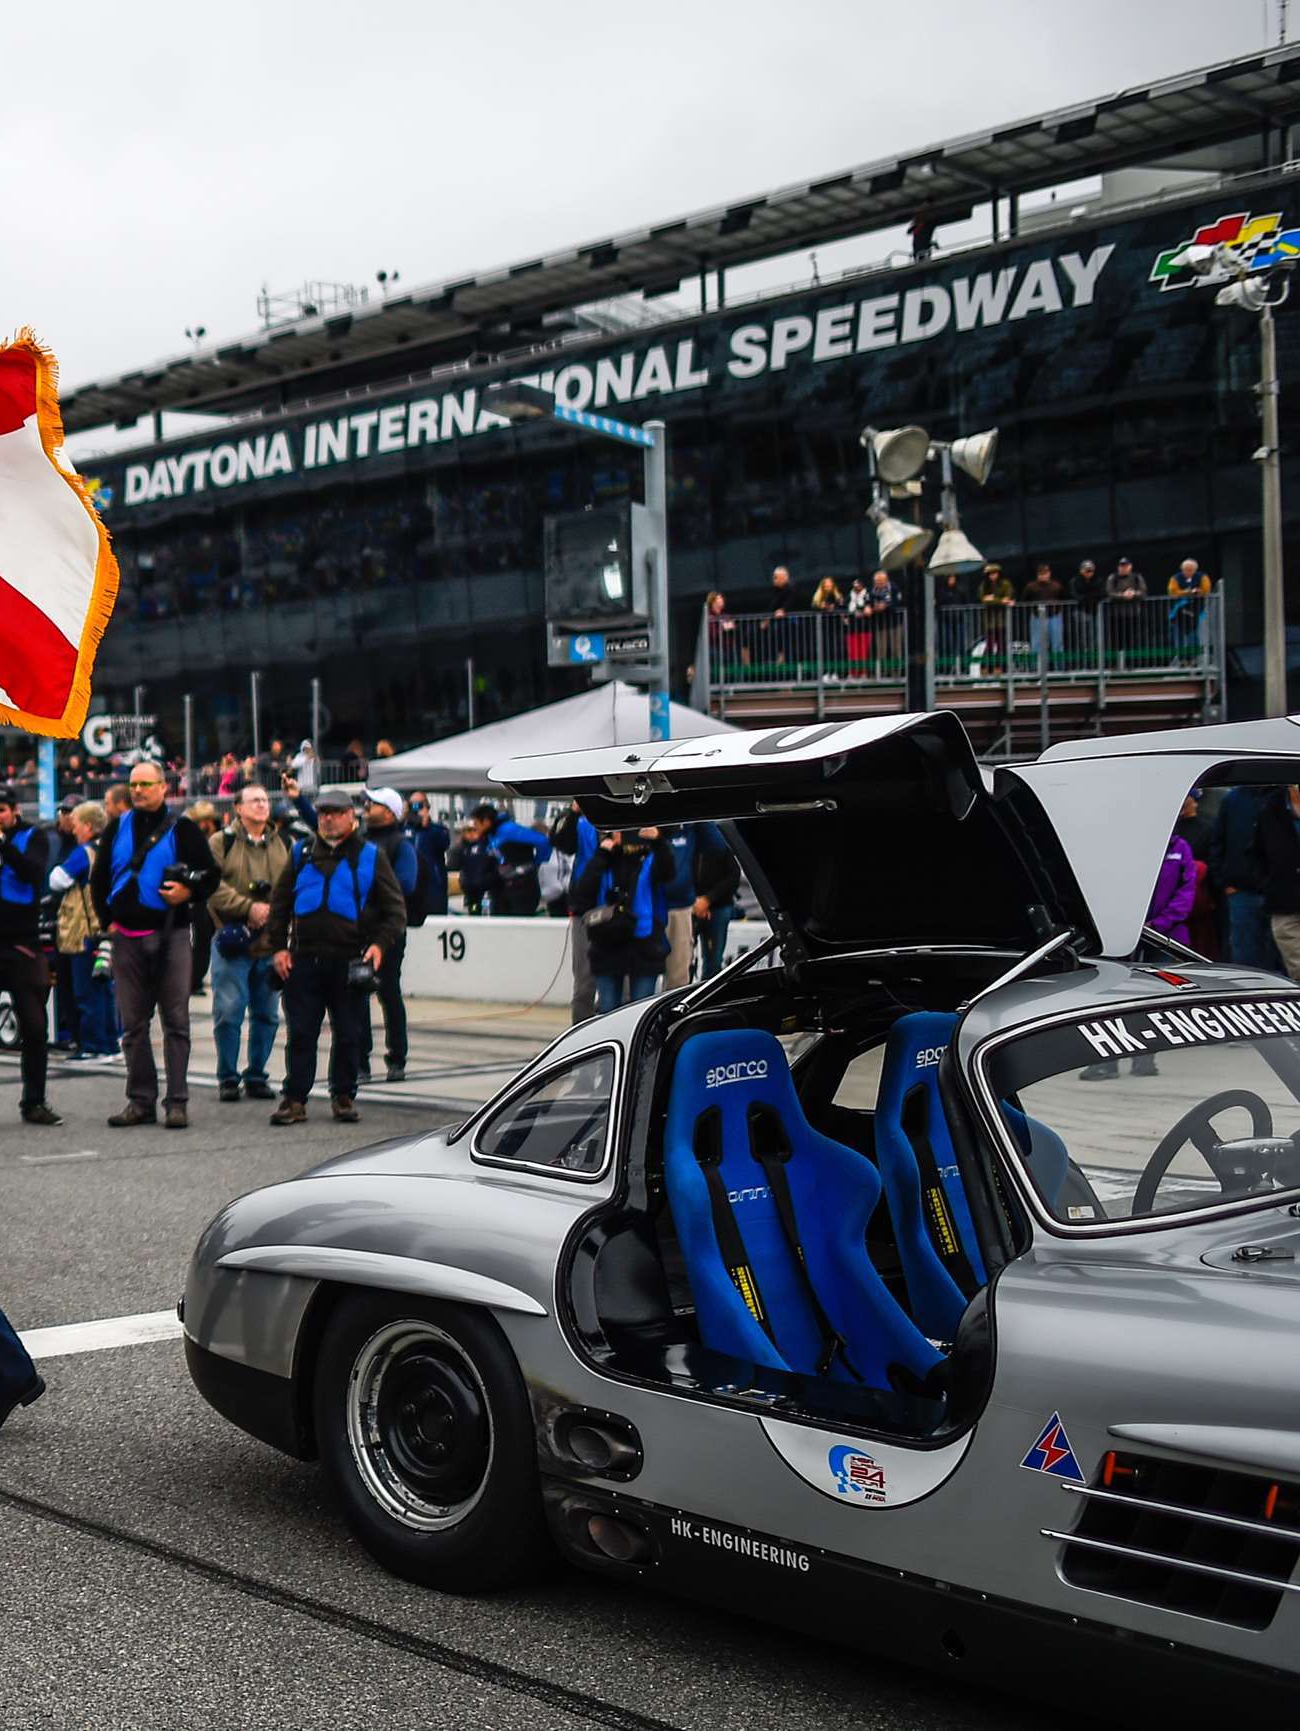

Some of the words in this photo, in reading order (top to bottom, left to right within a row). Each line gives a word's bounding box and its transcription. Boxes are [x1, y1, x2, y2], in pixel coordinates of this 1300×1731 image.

[125, 433, 293, 505] DAYTONA
[728, 244, 1117, 378] SPEEDWAY
[438, 930, 466, 961] 19
[1077, 1000, 1300, 1057] HK-ENGINEERI
[706, 1058, 768, 1088] sparco
[850, 1466, 886, 1489] 24
[671, 1518, 810, 1571] HK-ENGINEERING
